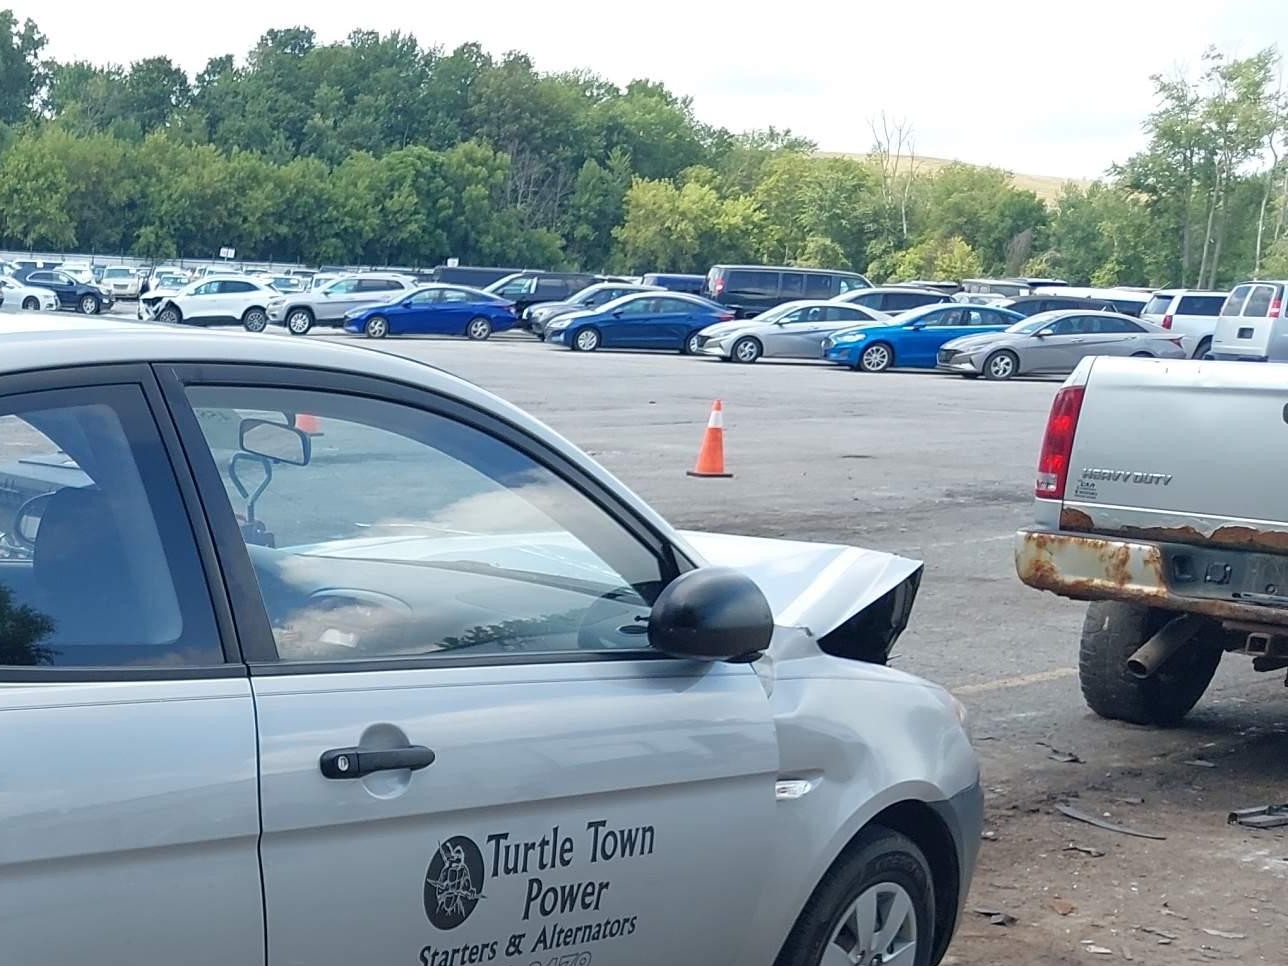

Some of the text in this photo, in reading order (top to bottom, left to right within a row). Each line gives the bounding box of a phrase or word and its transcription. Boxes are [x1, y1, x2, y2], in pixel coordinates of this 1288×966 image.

[1082, 468, 1173, 486] HEAVY DUTY
[486, 819, 655, 878] Turtle Town
[521, 877, 610, 921] Power
[504, 933, 526, 958] &
[530, 915, 638, 954] Alternators
